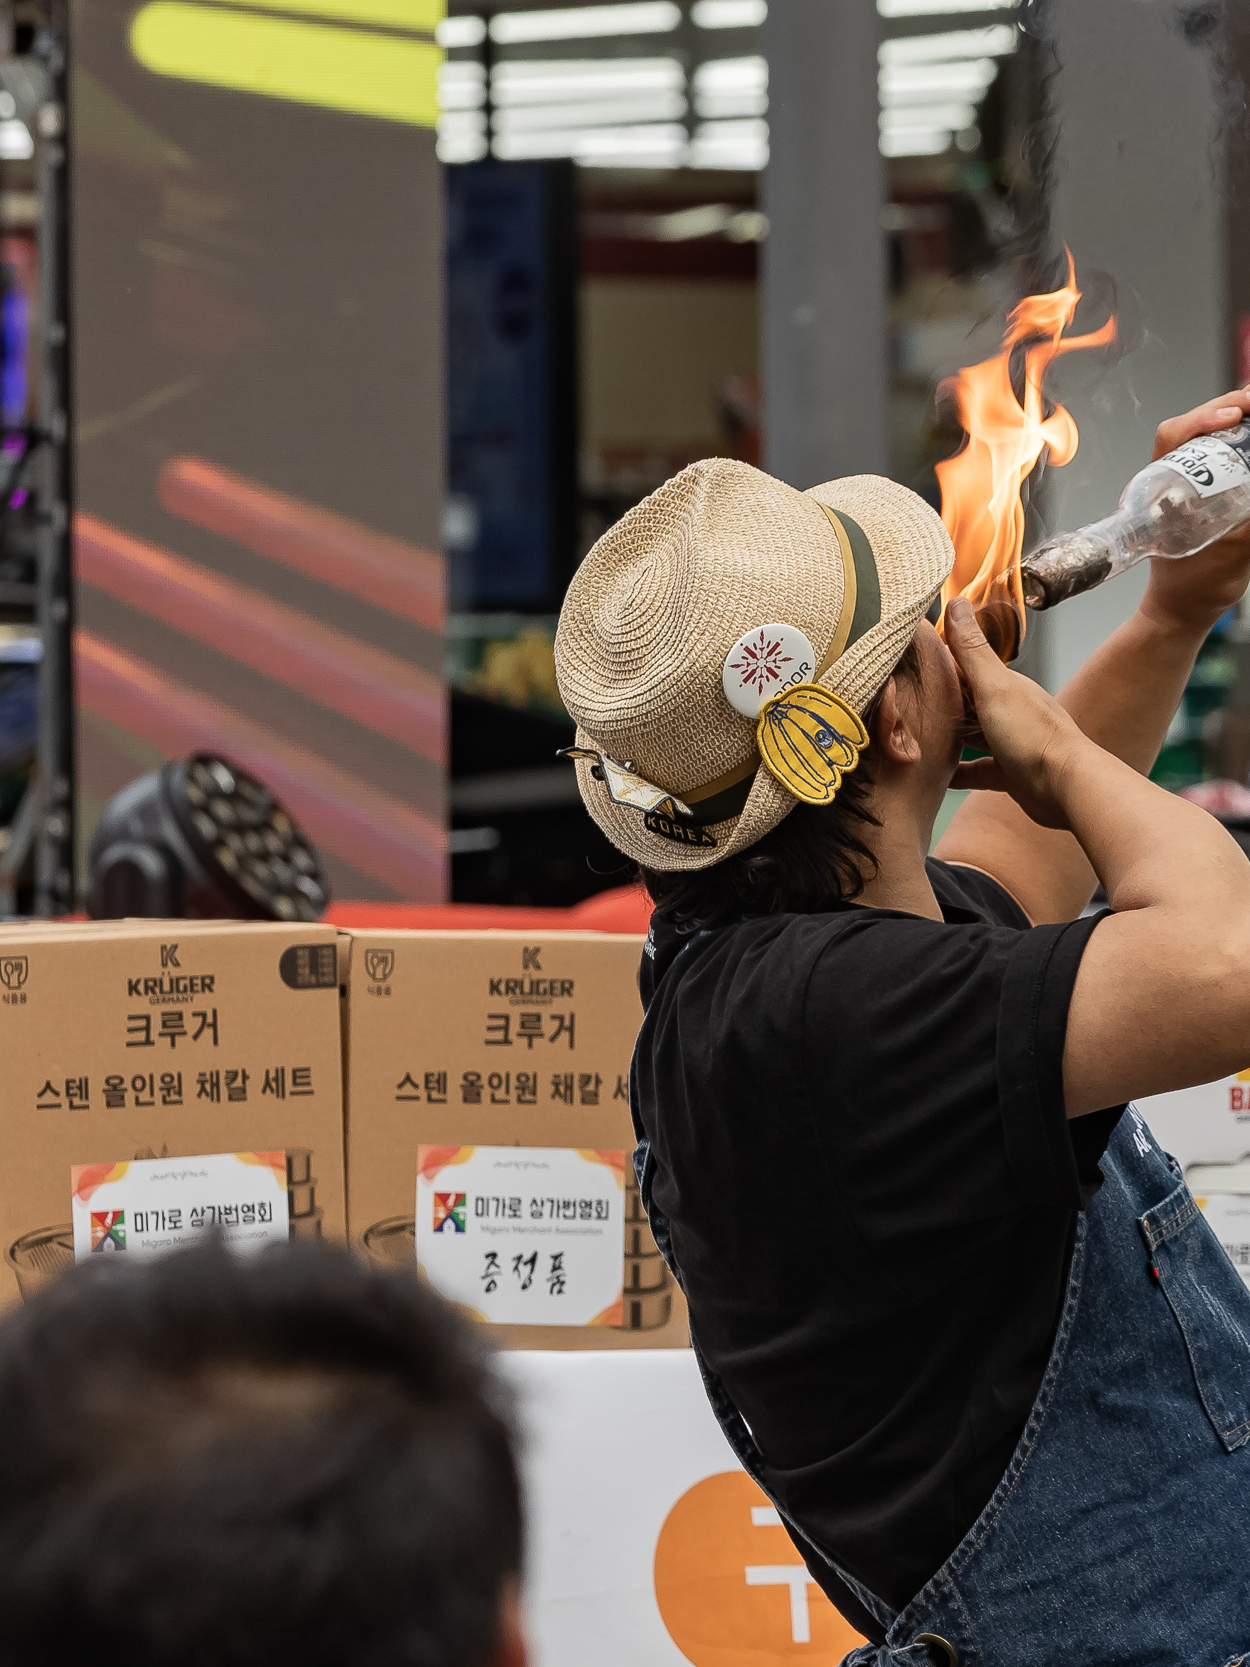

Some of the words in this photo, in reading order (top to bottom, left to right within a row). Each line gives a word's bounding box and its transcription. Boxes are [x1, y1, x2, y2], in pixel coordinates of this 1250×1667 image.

[647, 815, 712, 843] KOREA
[126, 1008, 219, 1049] 크루거
[484, 1011, 576, 1050] 크루거
[36, 1076, 90, 1110] 스텐
[102, 1071, 183, 1108] 올인원
[196, 1067, 250, 1103] 채칼
[261, 1065, 315, 1099] 세트
[395, 1071, 447, 1105] 스텐
[460, 1071, 538, 1105] 올인원
[551, 1072, 602, 1106] 채칼
[134, 1208, 183, 1233] 미가로
[190, 1200, 273, 1228] 상가번영회
[475, 1196, 522, 1219] 미가로
[530, 1197, 610, 1221] 상가번영회
